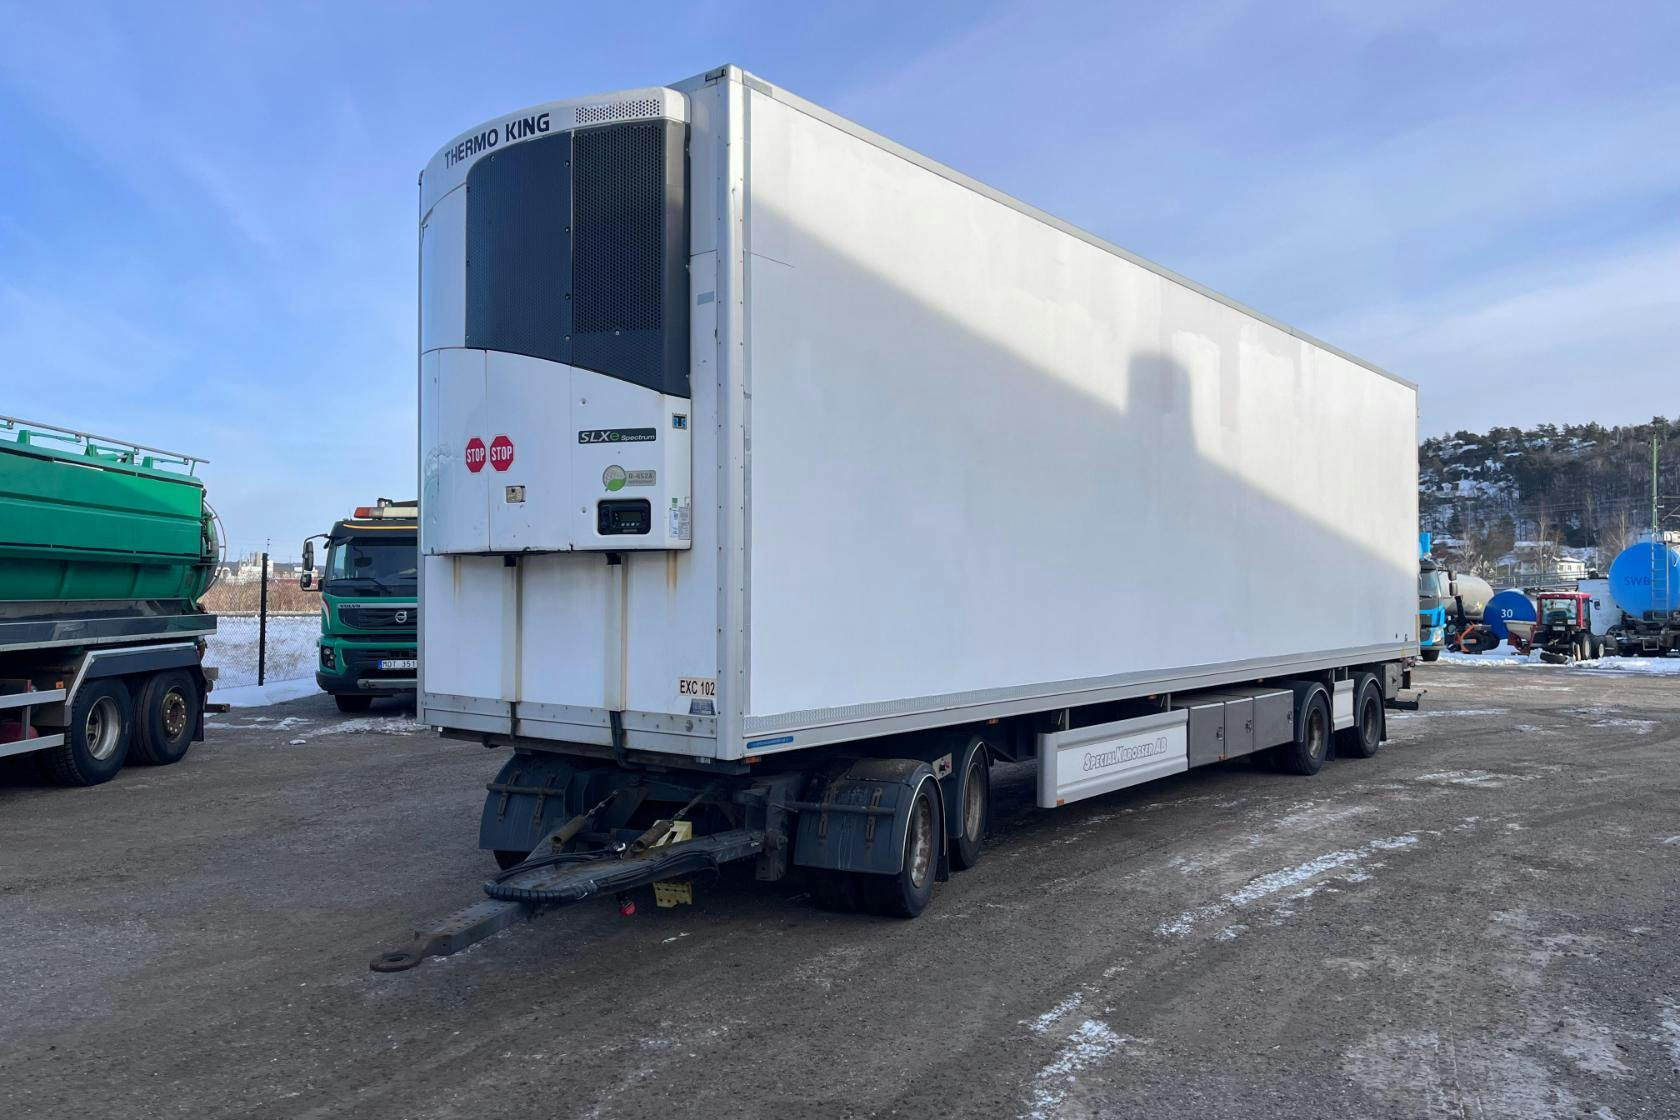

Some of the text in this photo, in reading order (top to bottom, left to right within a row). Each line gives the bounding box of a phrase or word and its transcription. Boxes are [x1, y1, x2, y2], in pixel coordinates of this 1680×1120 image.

[444, 112, 550, 169] THERMO KING
[580, 431, 620, 443] SLXe
[466, 448, 485, 463] STOP
[491, 446, 512, 461] STOP
[1500, 608, 1514, 619] 30
[680, 679, 715, 696] EXC 102
